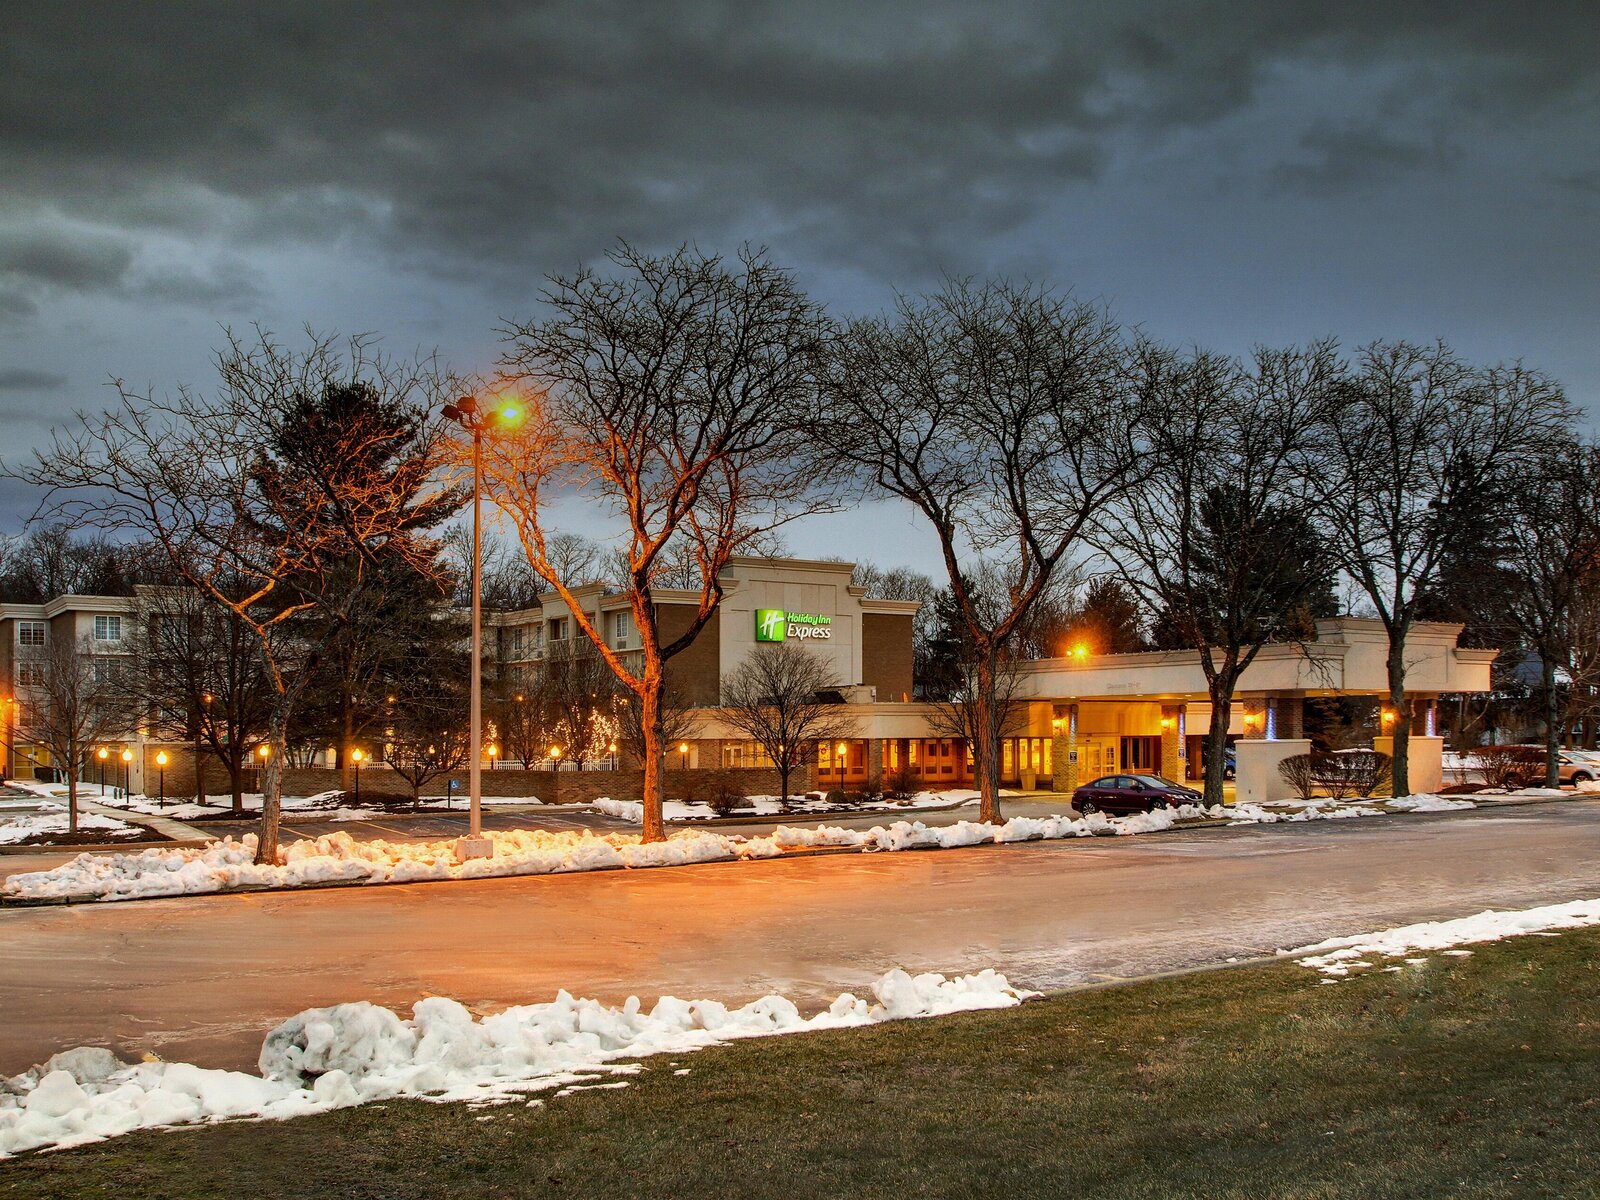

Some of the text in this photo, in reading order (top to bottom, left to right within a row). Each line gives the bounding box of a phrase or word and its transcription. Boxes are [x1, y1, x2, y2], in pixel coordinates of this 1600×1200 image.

[787, 612, 832, 625] Holiday Inn
[787, 623, 831, 640] Express
